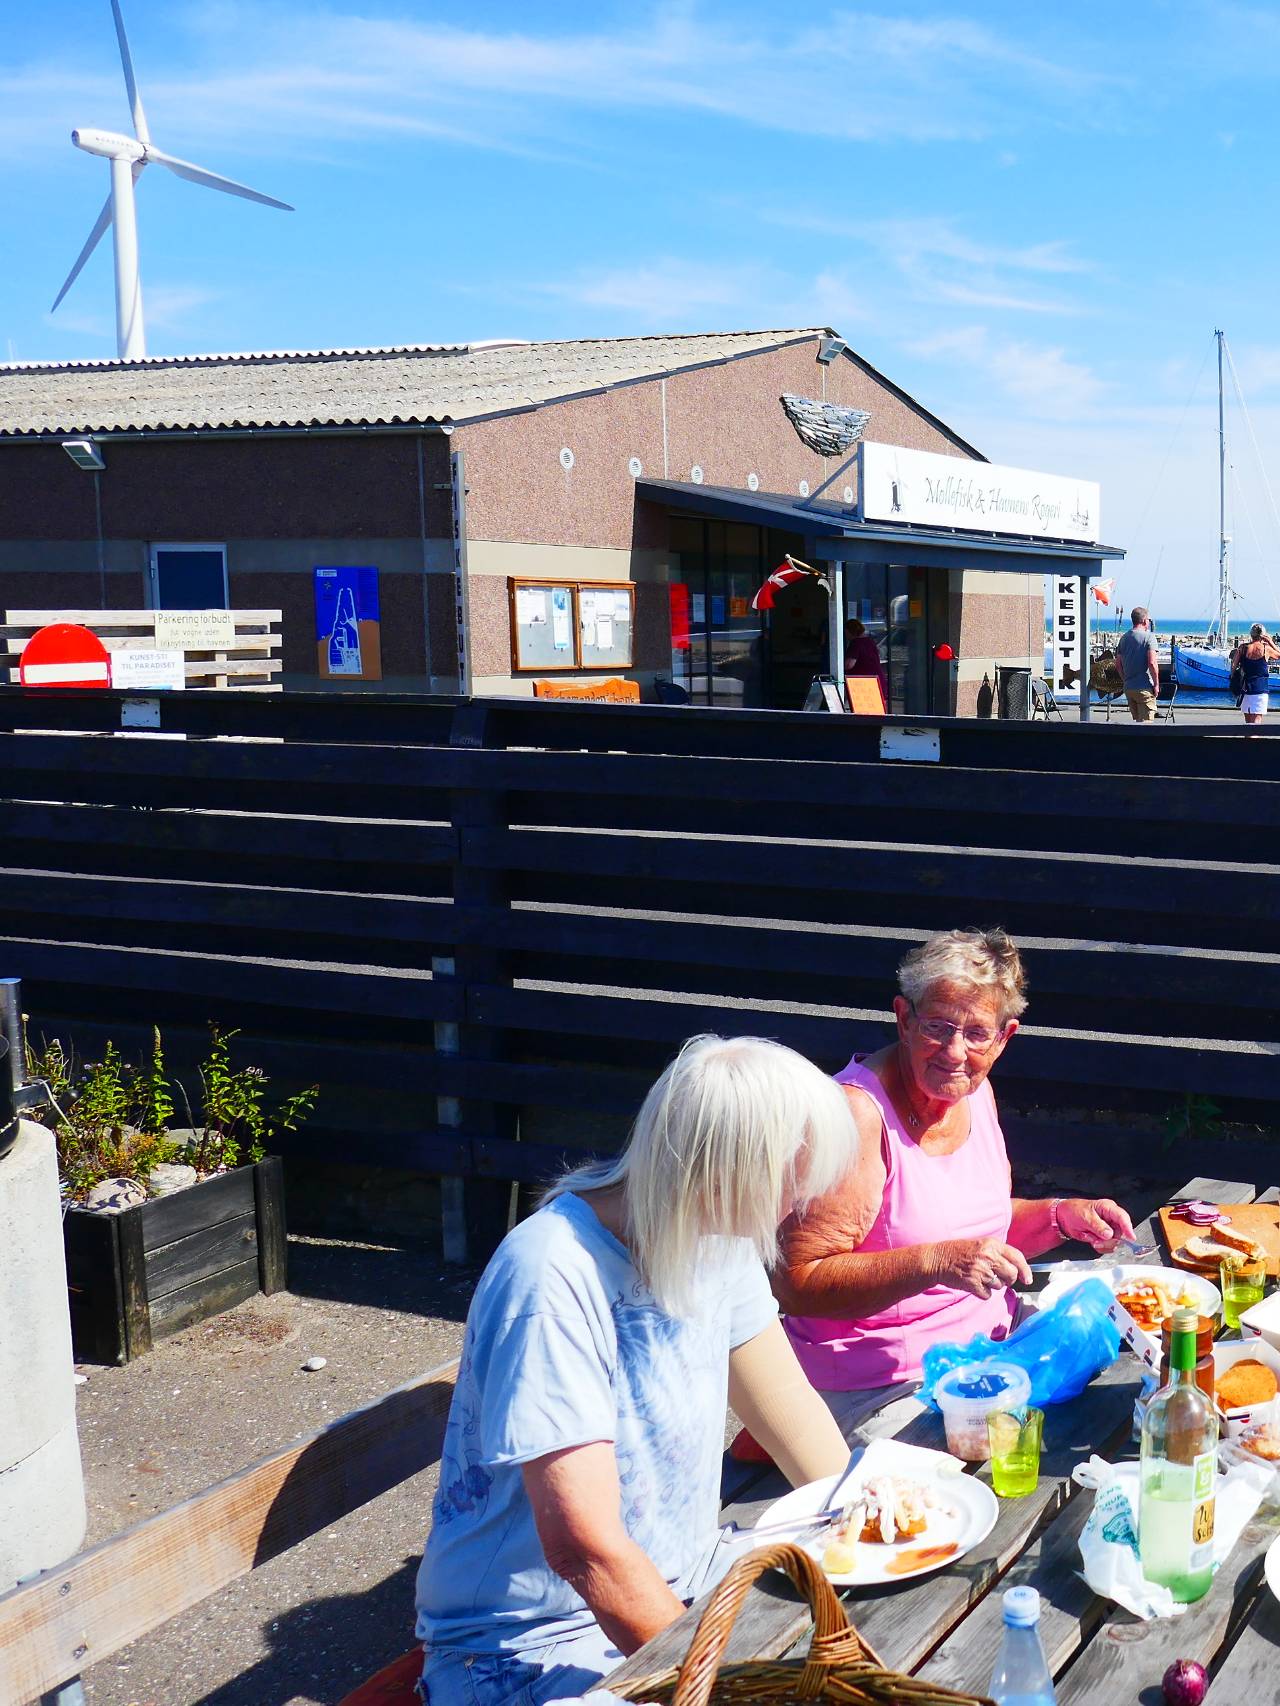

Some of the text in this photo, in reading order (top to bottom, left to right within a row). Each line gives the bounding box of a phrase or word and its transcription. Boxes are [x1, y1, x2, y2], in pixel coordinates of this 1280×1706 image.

[974, 488, 985, 515] &
[158, 612, 231, 627] Parkering forbudt
[120, 661, 176, 671] TIL PARADISET
